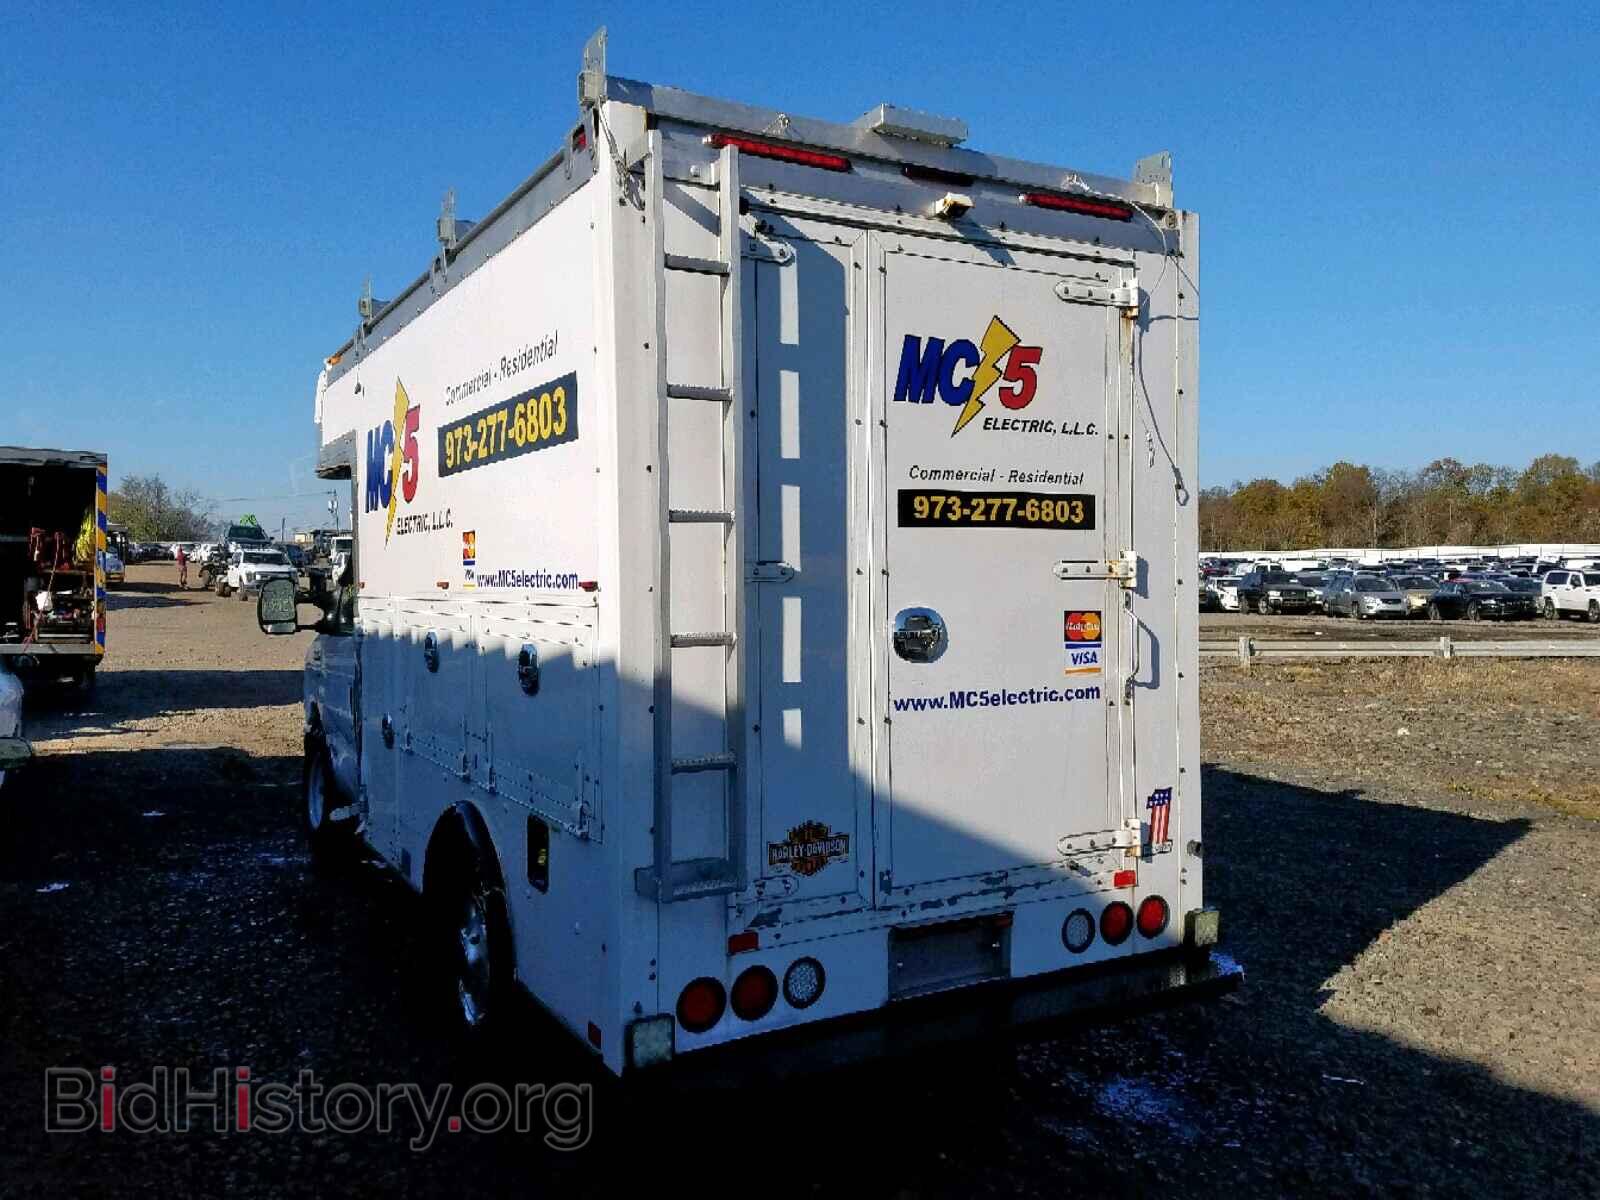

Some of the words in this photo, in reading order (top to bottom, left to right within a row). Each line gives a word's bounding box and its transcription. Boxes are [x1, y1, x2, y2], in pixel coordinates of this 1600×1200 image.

[446, 364, 492, 405] Commercial
[499, 329, 559, 382] Residential
[446, 387, 566, 468] 973-277-6803
[983, 417, 1057, 435] ELECTRIC,
[1061, 421, 1099, 436] L.L.C.
[909, 465, 995, 483] Commercial
[1007, 470, 1085, 486] Residential
[913, 495, 1085, 523] 973-277-6803
[396, 513, 430, 535] ELECTRIC,
[477, 568, 578, 589] www.MC5electric.com
[1071, 650, 1098, 665] VISA
[894, 686, 1100, 711] www.MC5electric.com
